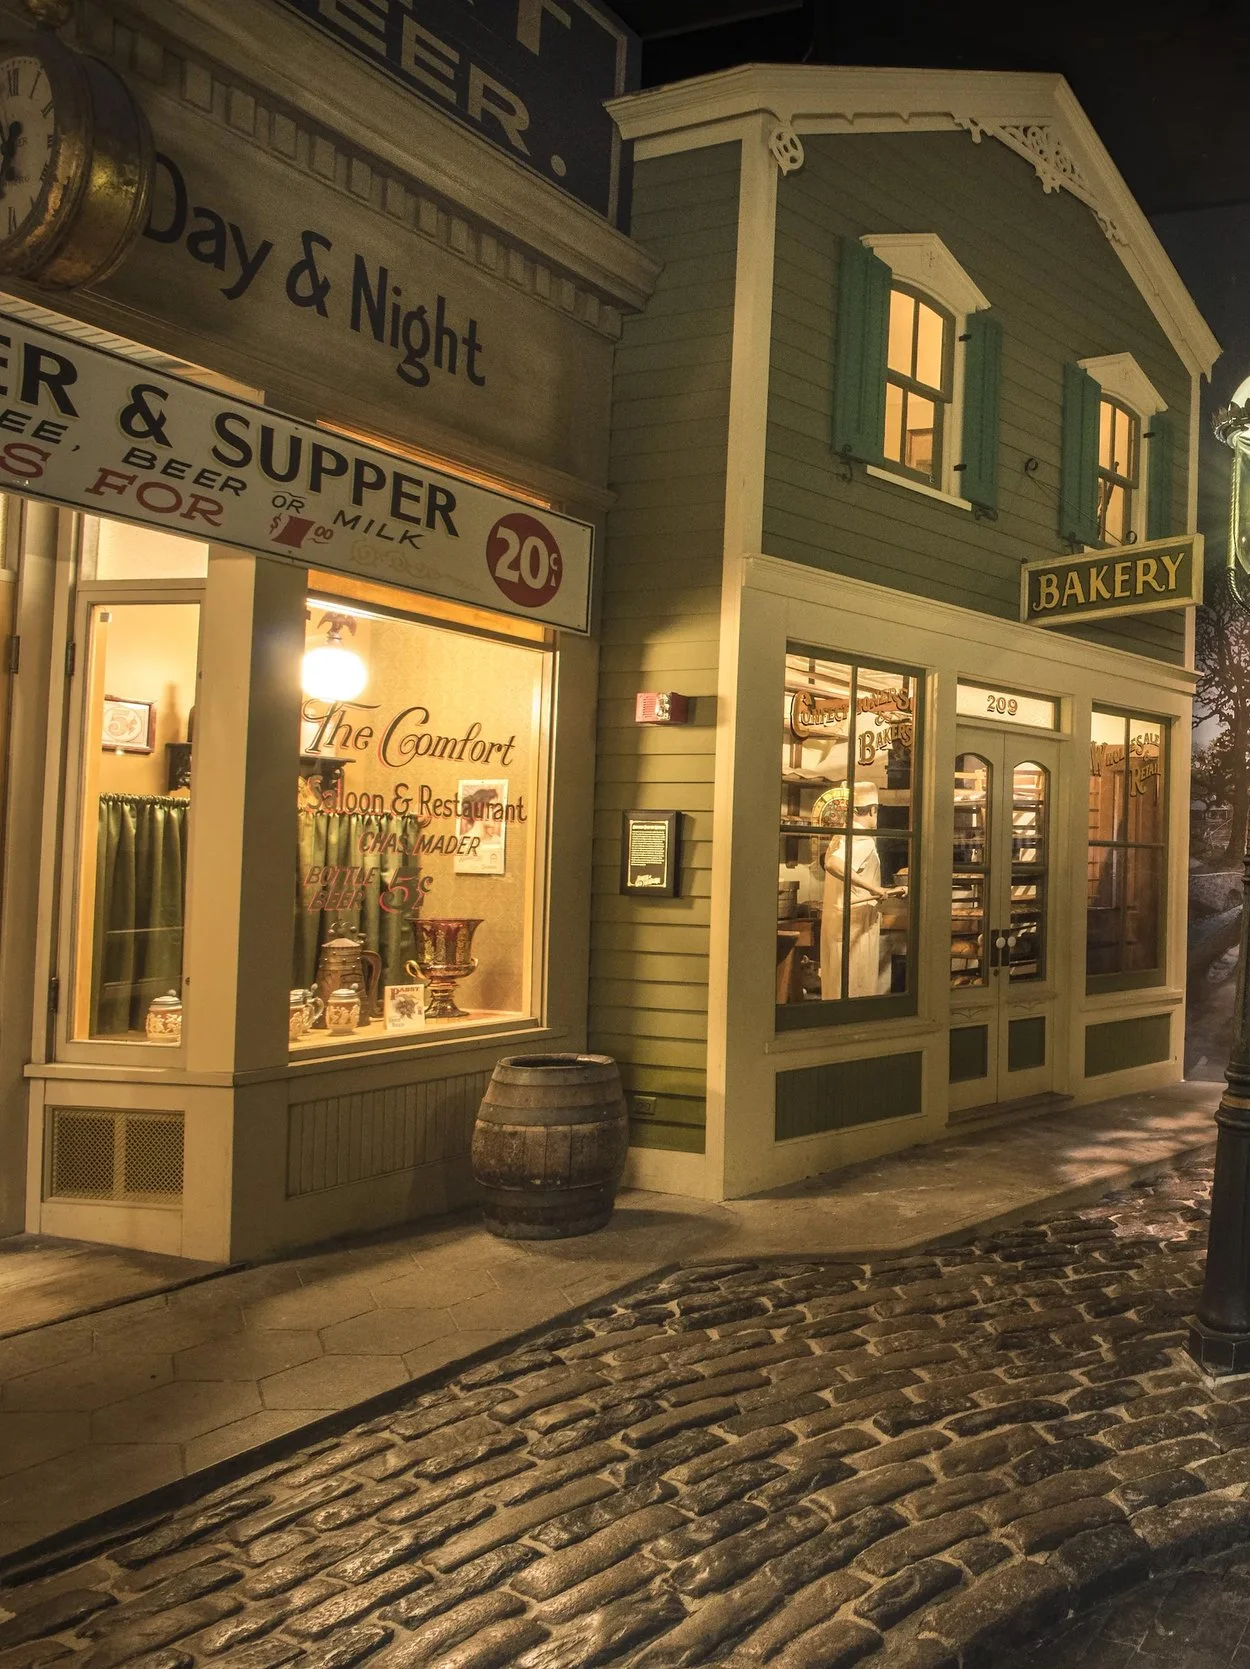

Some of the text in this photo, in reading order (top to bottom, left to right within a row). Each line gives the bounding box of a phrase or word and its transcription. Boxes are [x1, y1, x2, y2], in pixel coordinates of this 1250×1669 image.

[143, 152, 486, 387] Day & Night
[0, 333, 460, 538] R & SUPPER
[84, 467, 224, 527] FOR
[121, 446, 248, 497] BEER
[271, 494, 305, 514] OR
[332, 509, 425, 550] MILK
[1032, 552, 1185, 612] BAKERY
[303, 698, 517, 768] The Comfort
[986, 695, 1019, 717] 209
[305, 775, 528, 828] Saloon & Restaurant
[411, 834, 482, 857] MADER
[303, 865, 379, 888] BOTTLE
[307, 890, 366, 913] BEER
